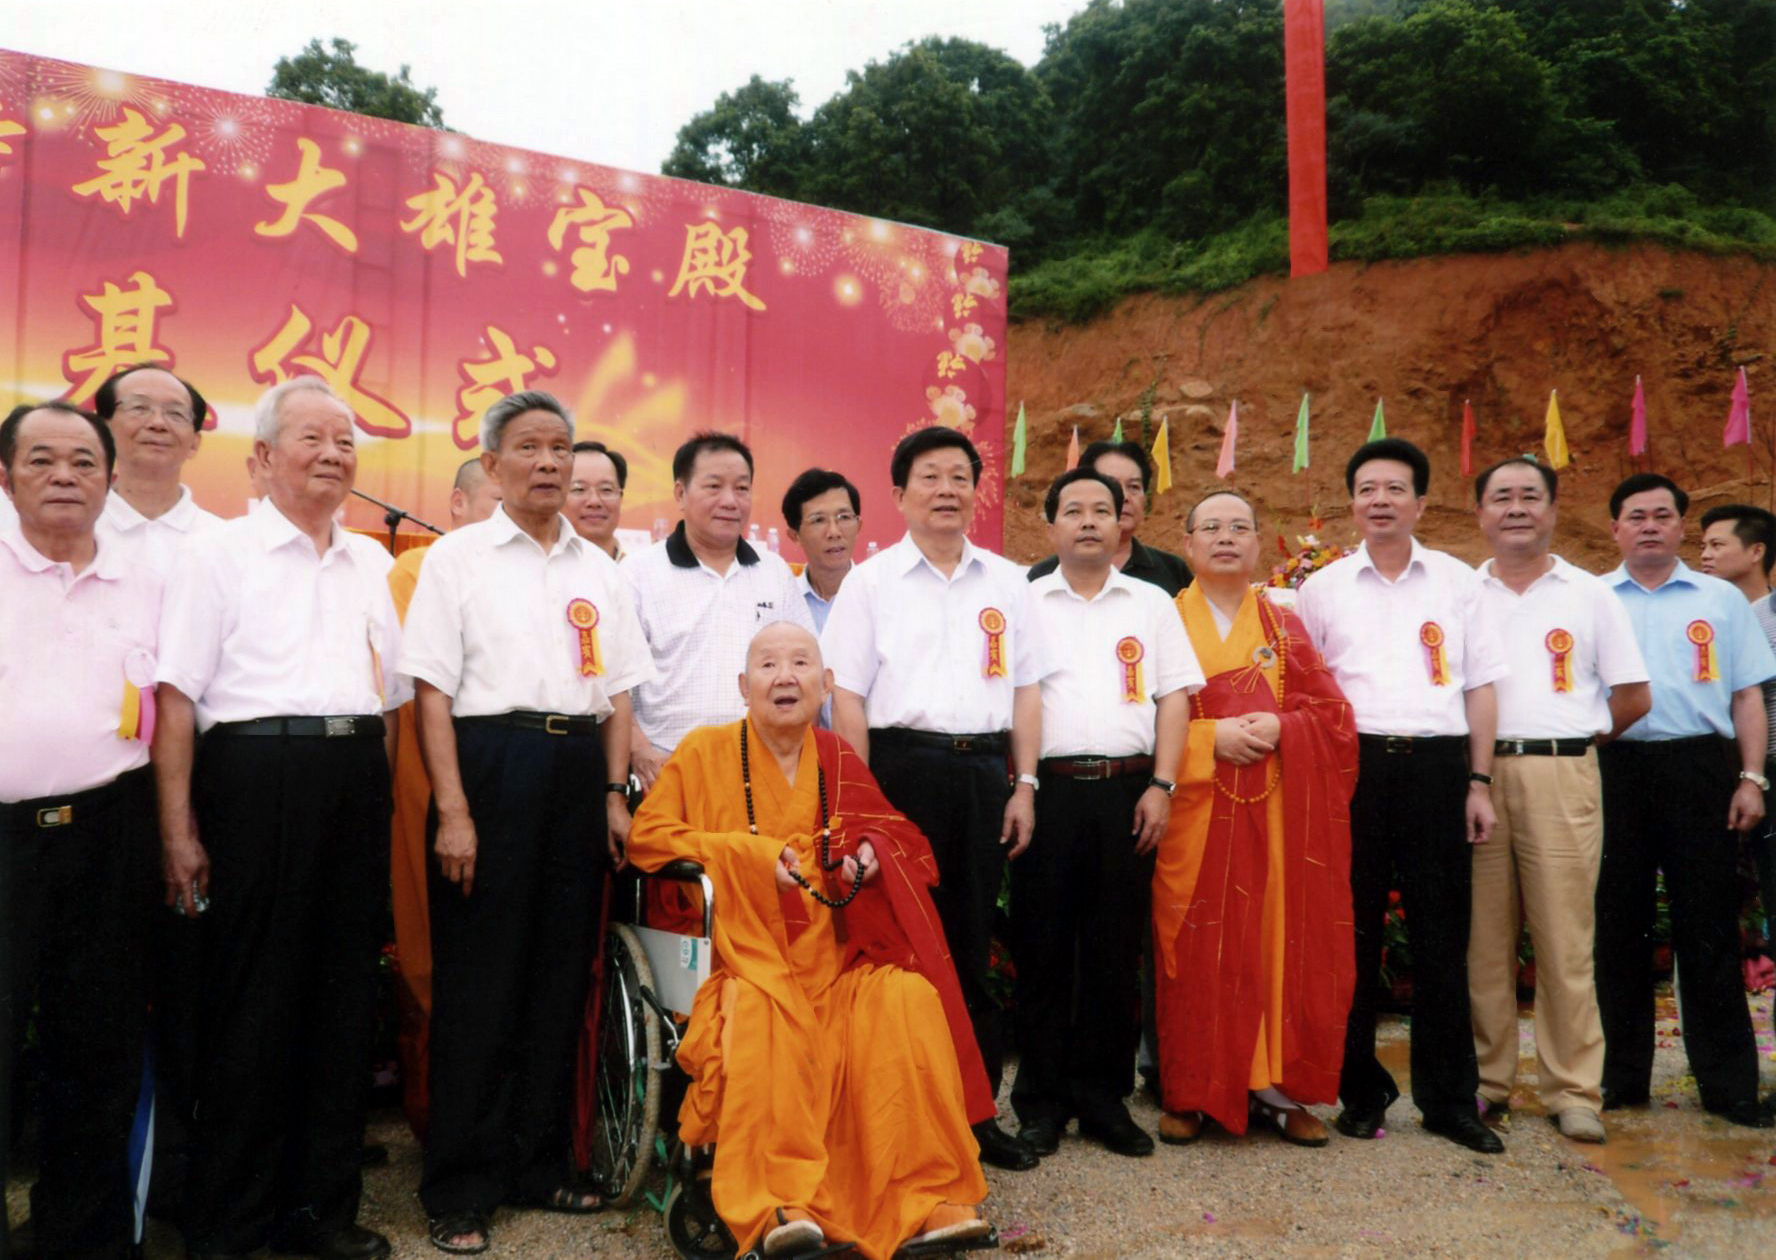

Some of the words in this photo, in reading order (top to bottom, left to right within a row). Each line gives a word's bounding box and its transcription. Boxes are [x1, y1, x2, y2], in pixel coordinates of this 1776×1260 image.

[0, 106, 767, 311] 新大雄宝殿
